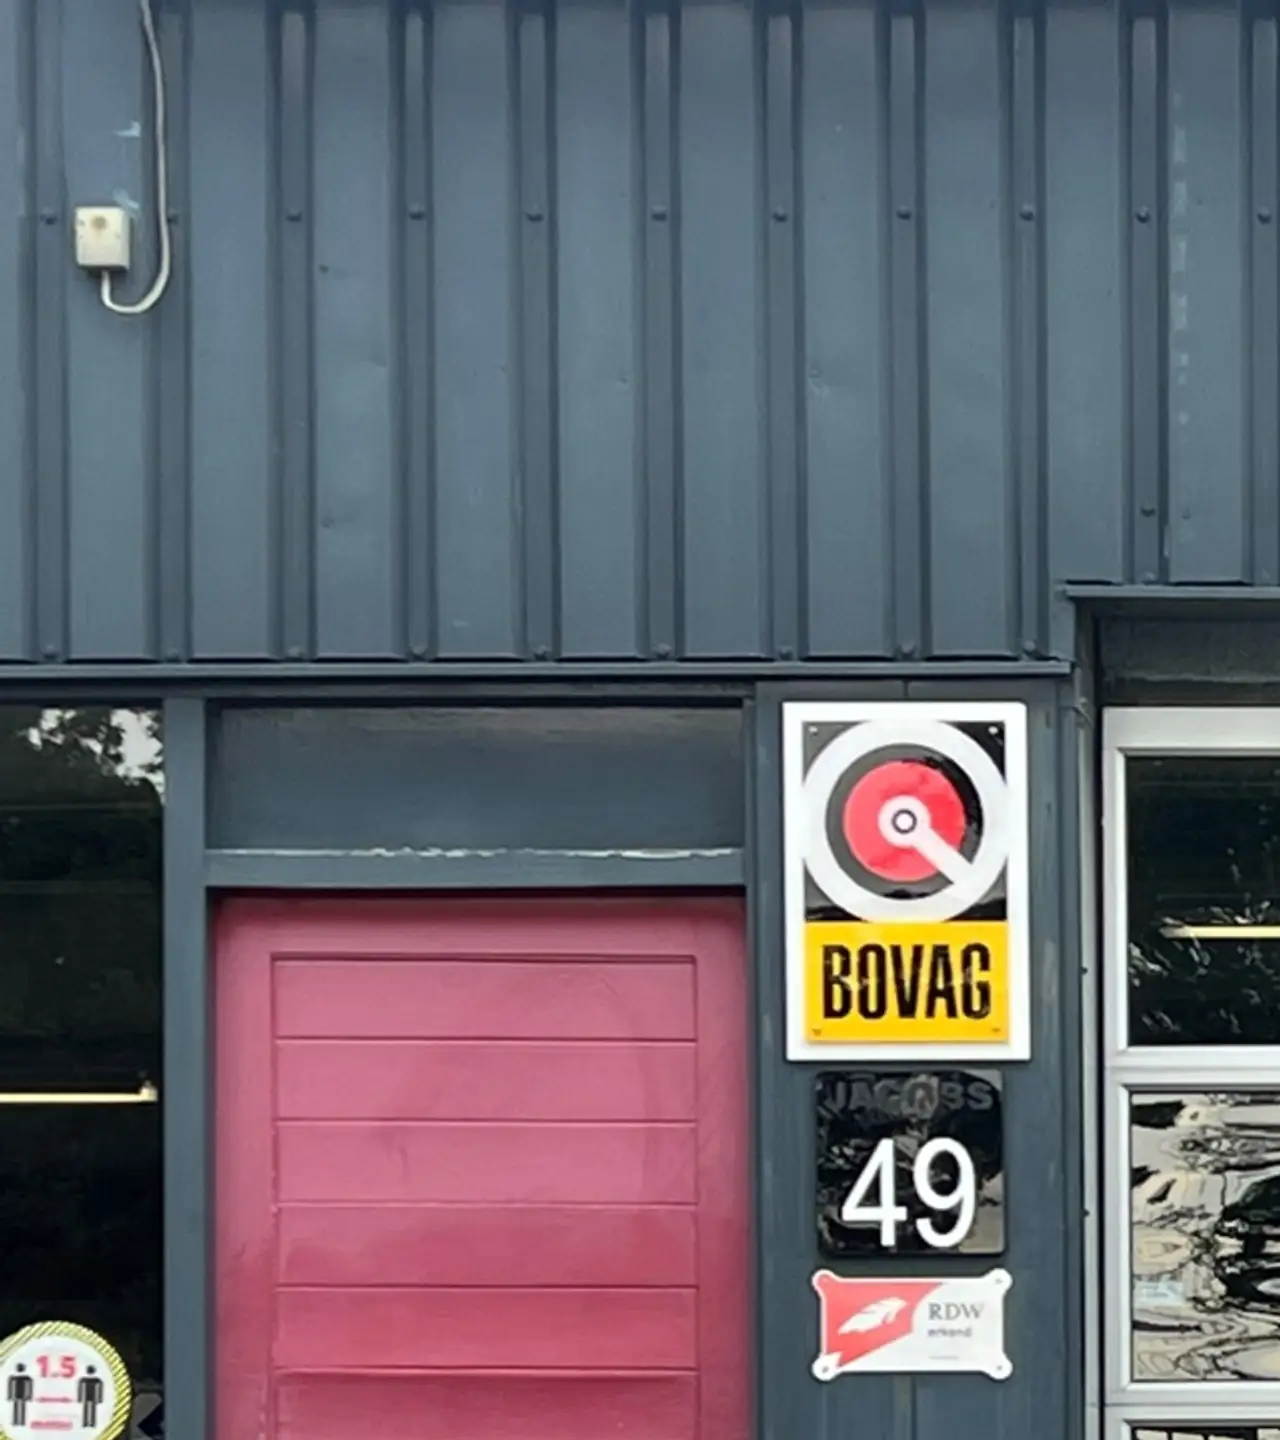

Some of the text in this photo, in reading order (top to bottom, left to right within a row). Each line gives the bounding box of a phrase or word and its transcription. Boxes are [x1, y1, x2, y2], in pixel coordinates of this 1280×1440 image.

[822, 943, 992, 1021] BOVAG
[822, 1080, 994, 1113] JACOBS
[841, 1137, 977, 1248] 49
[928, 1302, 985, 1321] RDW
